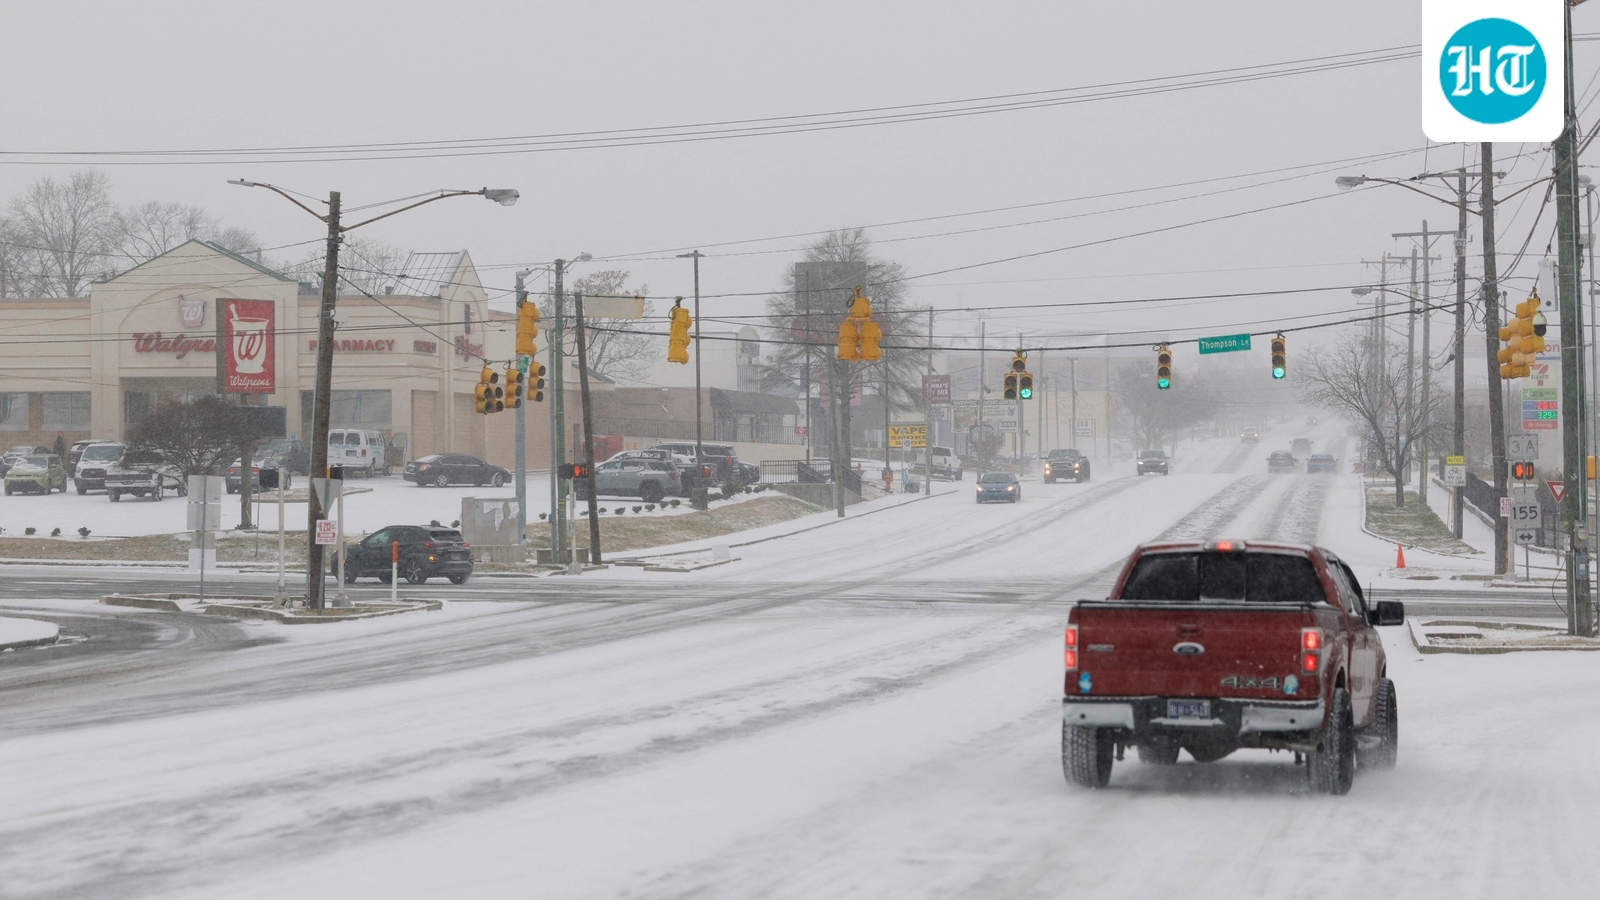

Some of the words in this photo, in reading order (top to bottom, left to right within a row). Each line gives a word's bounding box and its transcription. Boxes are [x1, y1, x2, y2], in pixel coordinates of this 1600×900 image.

[236, 329, 264, 361] W
[309, 339, 395, 352] PARMACY
[1201, 340, 1237, 349] Thompson
[230, 376, 270, 389] Walgreens
[892, 427, 926, 435] VAPE
[1512, 505, 1538, 520] 155
